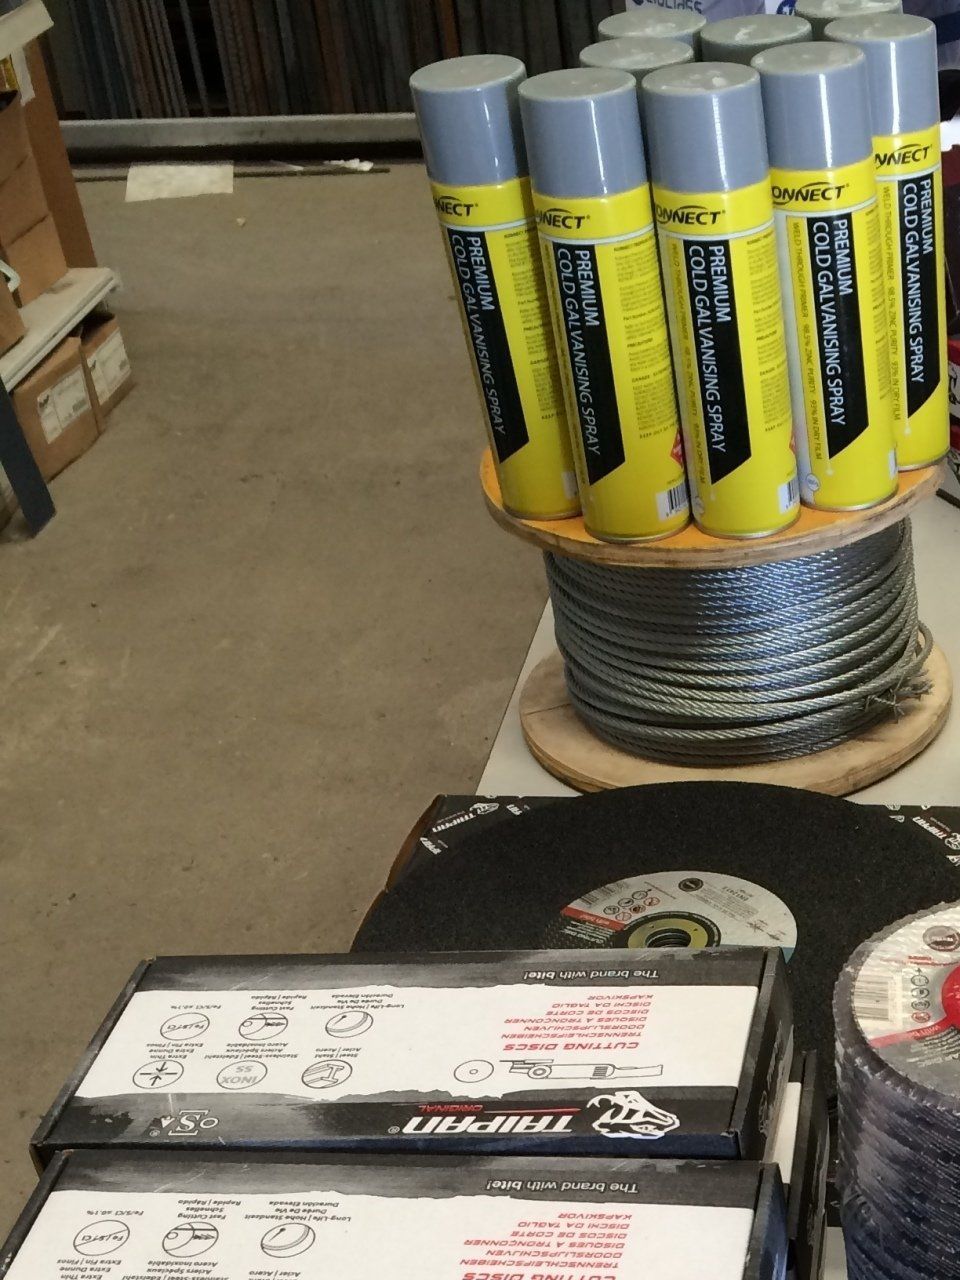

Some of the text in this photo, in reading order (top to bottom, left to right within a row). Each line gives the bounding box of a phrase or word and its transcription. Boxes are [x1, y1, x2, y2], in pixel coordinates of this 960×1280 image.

[920, 179, 933, 254] PREMIUM
[467, 236, 494, 310] PREMIUM
[575, 250, 600, 326] PREMIUM
[709, 246, 731, 322] PREMIUM
[833, 220, 853, 295] PREMIUM
[903, 183, 924, 383] COLD GALVANISING SPRAY
[452, 235, 506, 435] COLD GALVANISING SPRAY
[558, 249, 600, 455] COLD GALVANISING SPRAY
[689, 246, 726, 452] COLD GALVANISING SPRAY
[812, 222, 845, 425] COLD GALVANISING SPRAY
[522, 970, 659, 980] The brand with bite!
[502, 1042, 640, 1051] CUTTING DISCS
[402, 1115, 579, 1134] TAIPAN
[418, 1105, 484, 1113] ORIGINAL
[486, 1179, 640, 1194] The brand with bite!
